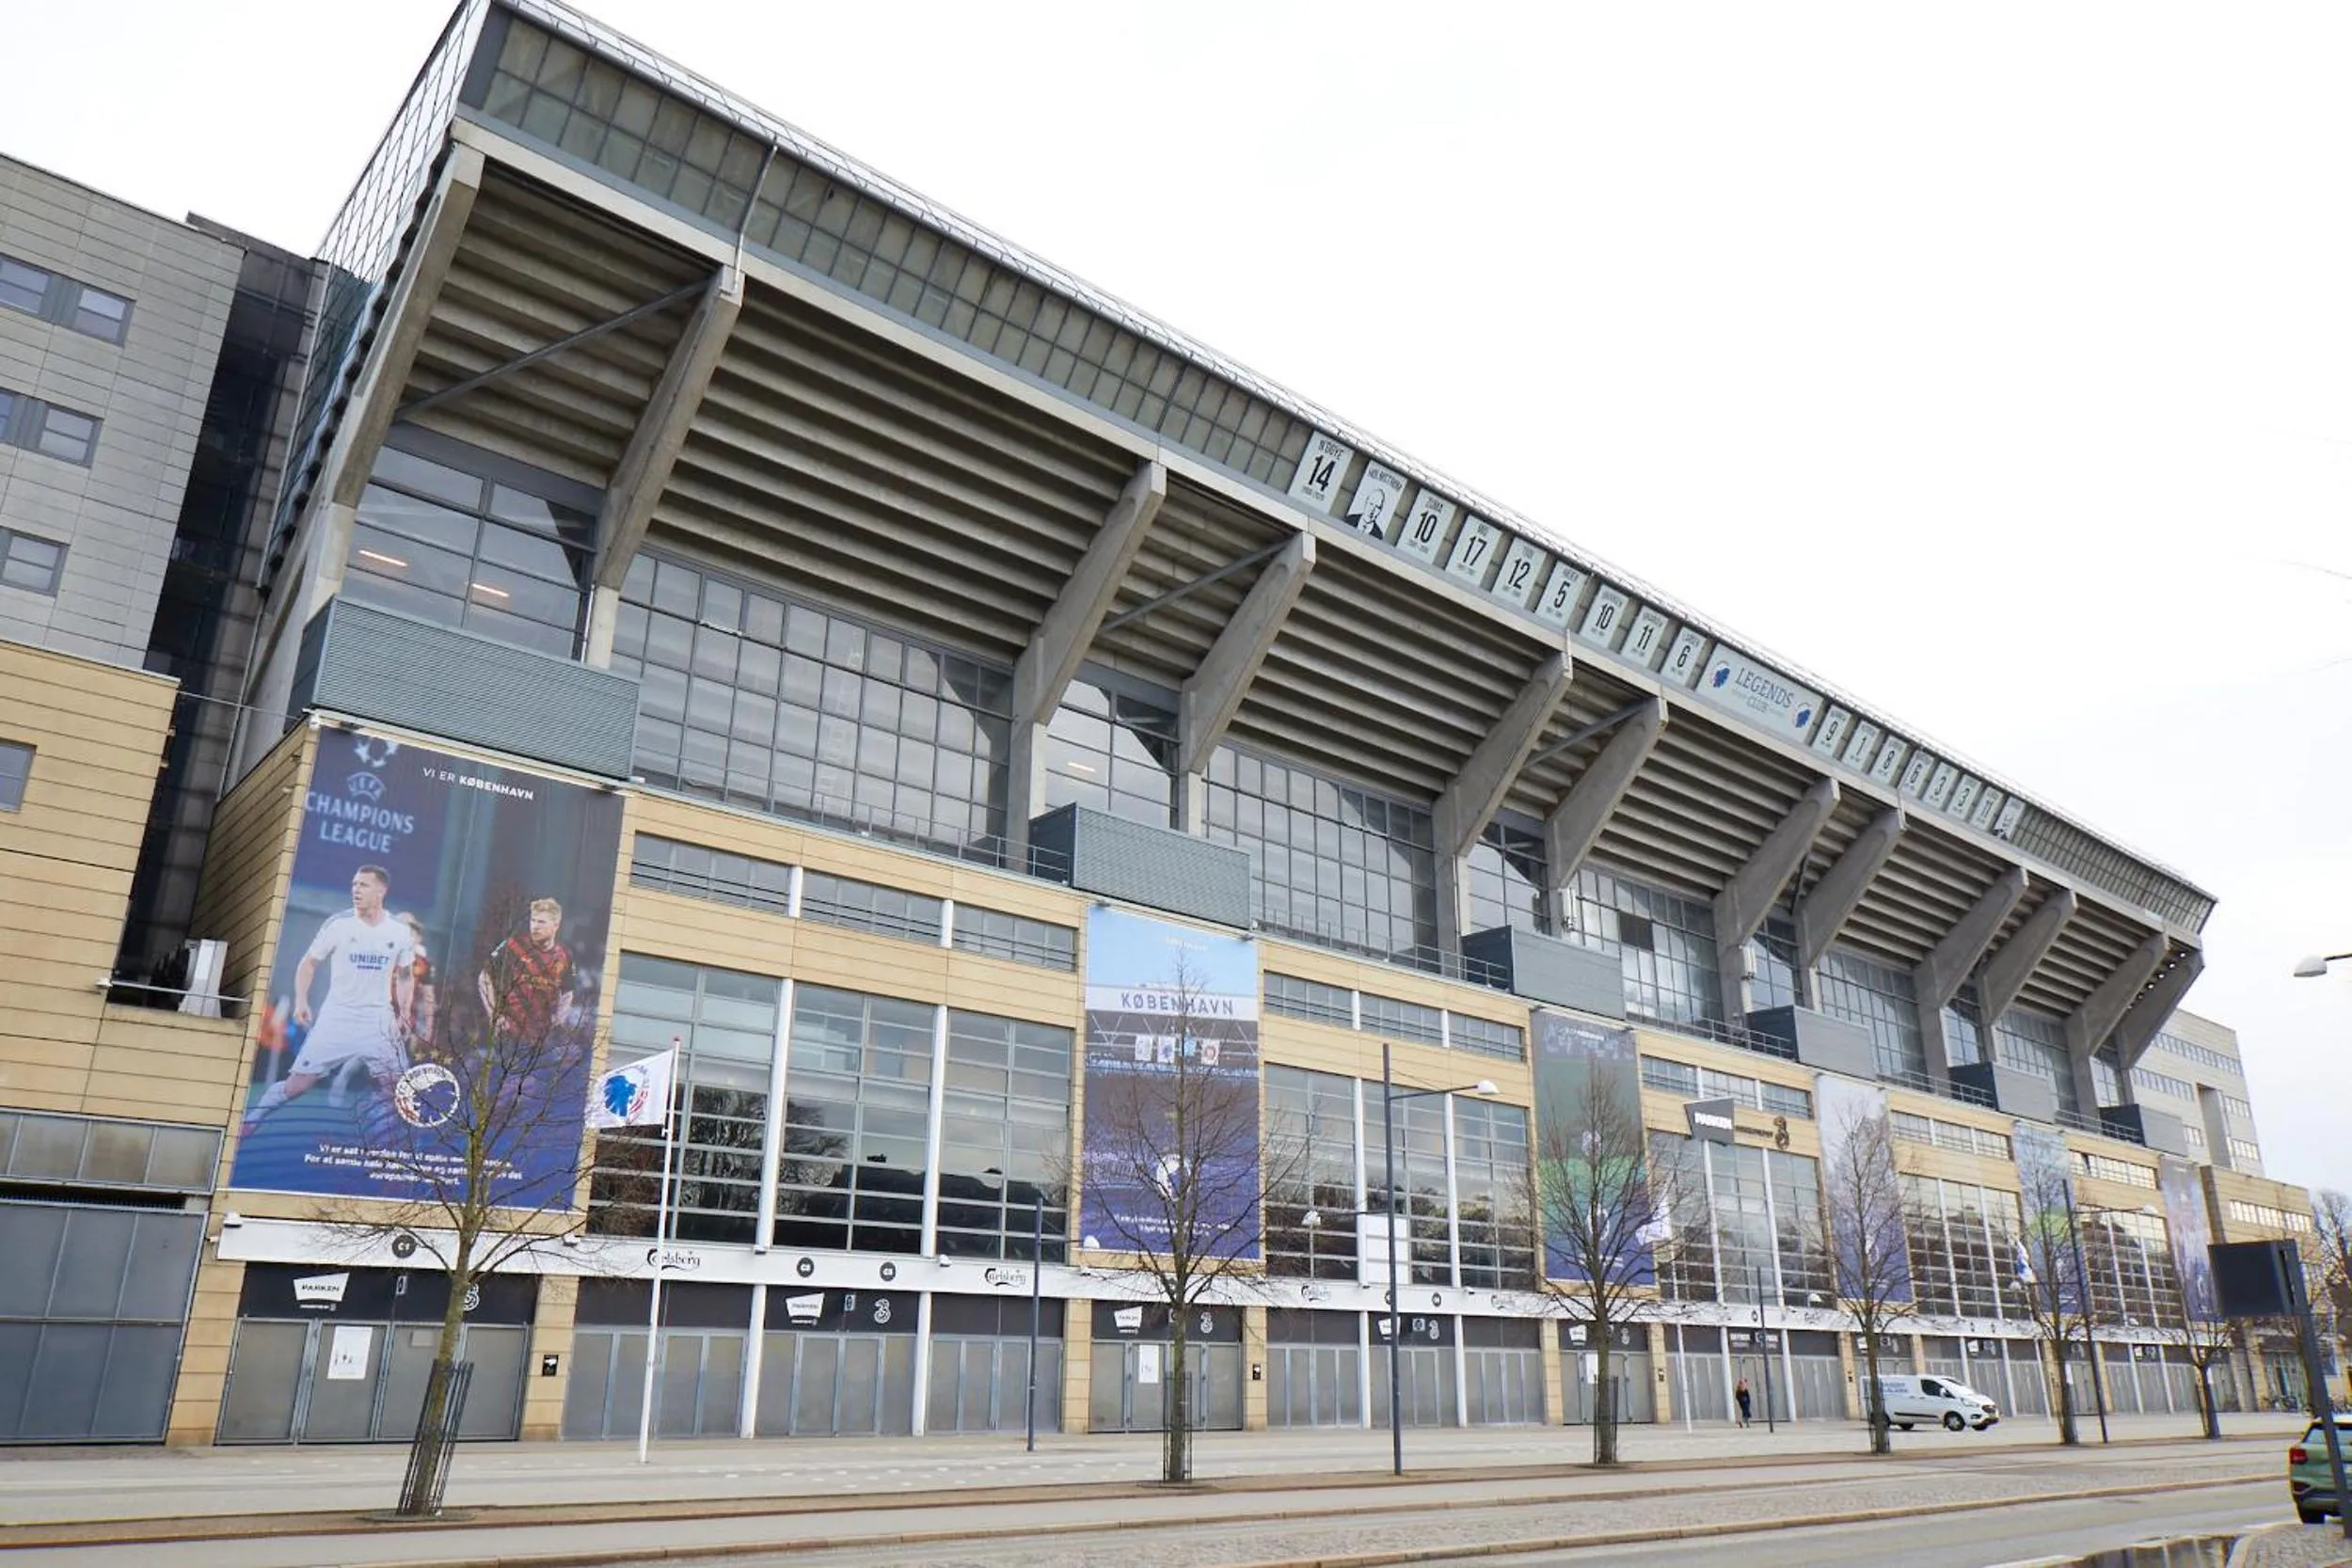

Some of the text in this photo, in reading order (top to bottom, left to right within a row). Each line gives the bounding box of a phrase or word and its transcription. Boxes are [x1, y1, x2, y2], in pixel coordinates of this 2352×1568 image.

[1308, 455, 1336, 491] 14
[1415, 512, 1437, 543] 10
[1463, 536, 1487, 566] 17
[1508, 558, 1531, 590] 12
[1553, 580, 1570, 609] 5
[1596, 603, 1614, 629] 10
[1637, 625, 1654, 650] 11
[1677, 645, 1691, 668] 6
[1735, 667, 1794, 708] LEGENDS
[1826, 721, 1838, 741] 9
[349, 774, 385, 800] UEFA
[423, 768, 534, 800] VI ER KØBENHAVN
[305, 791, 415, 834] CHAMPIONS
[319, 821, 392, 853] LEAGUE
[1121, 992, 1234, 1015] KØBENHAVN
[301, 1283, 340, 1291] PARKEN
[874, 1298, 892, 1323] 3
